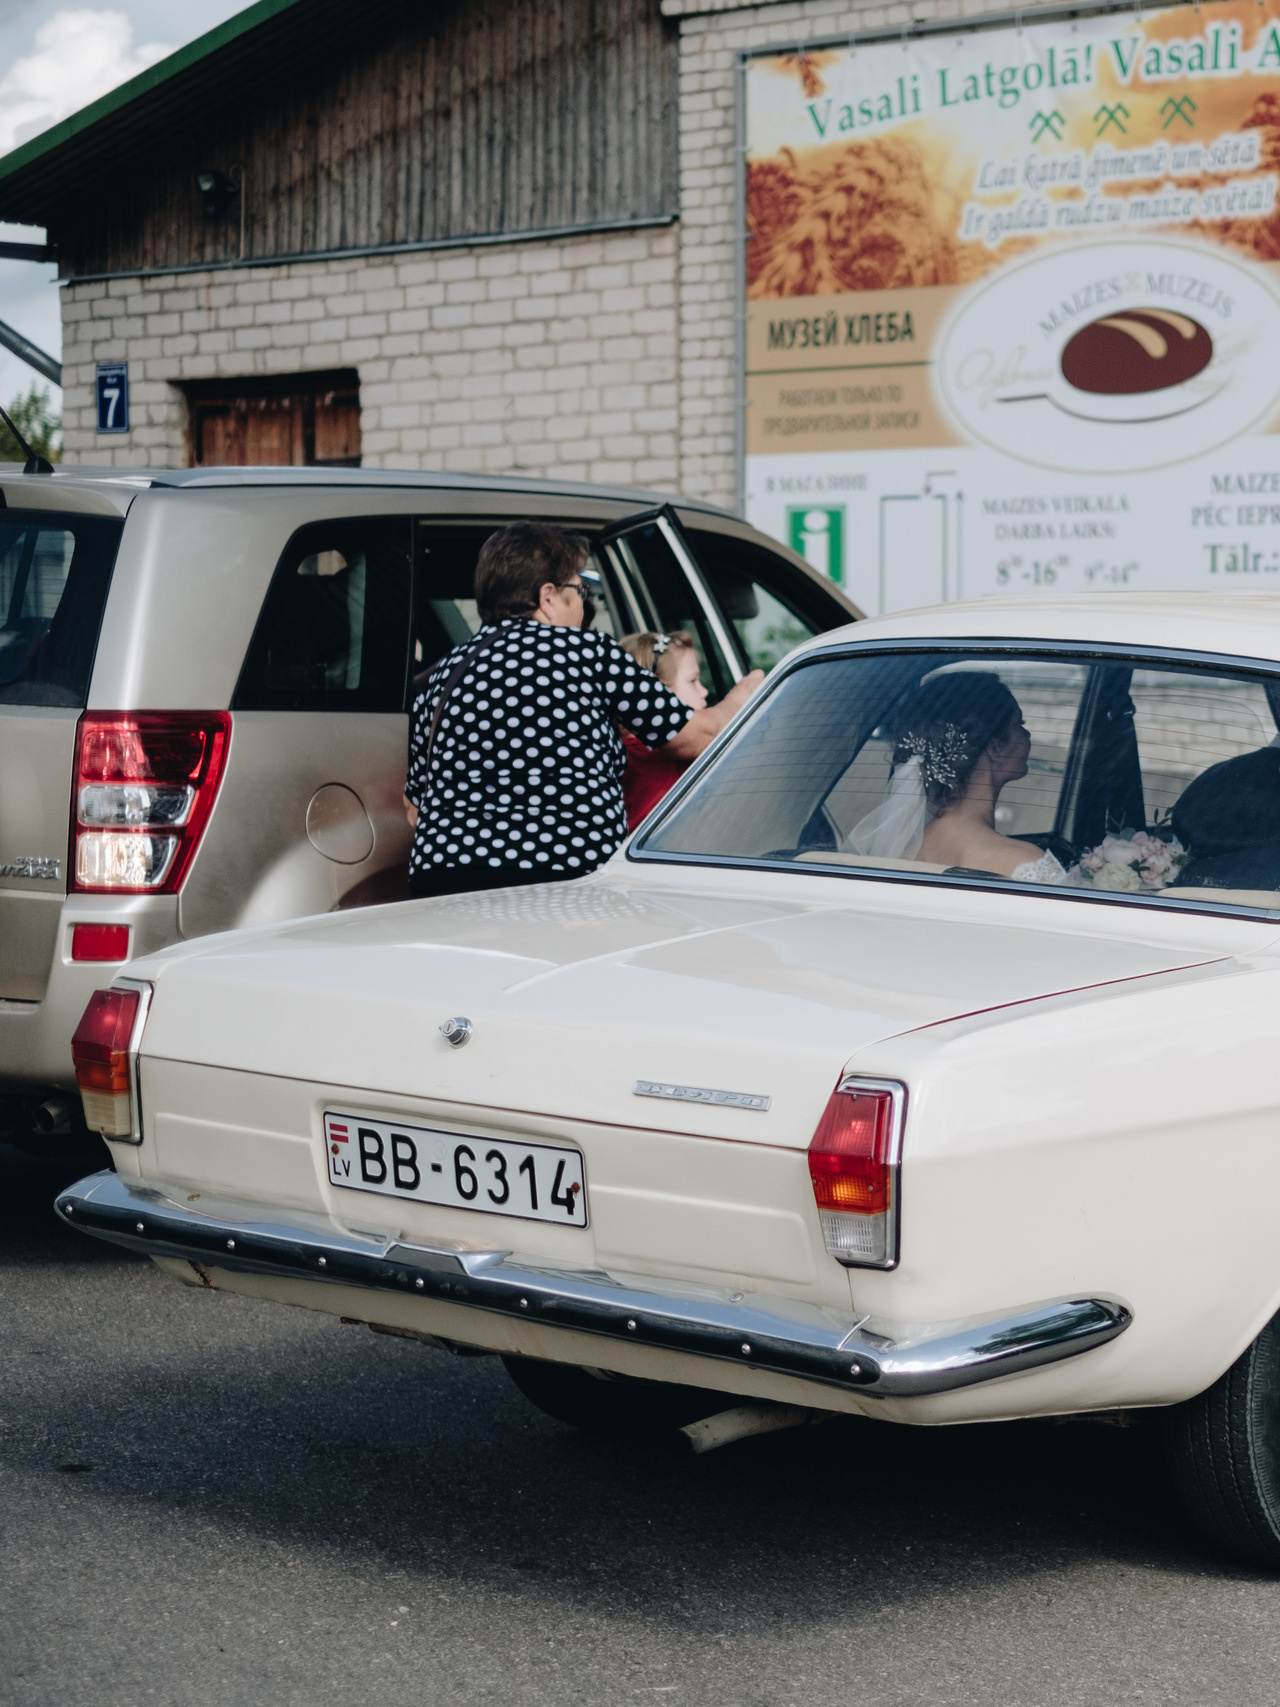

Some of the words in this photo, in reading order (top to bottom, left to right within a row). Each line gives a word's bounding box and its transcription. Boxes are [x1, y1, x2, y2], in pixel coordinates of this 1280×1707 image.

[806, 74, 921, 139] Vasali
[937, 43, 1094, 109] Latgolā!
[1110, 28, 1238, 78] Vasali
[1038, 277, 1124, 339] MAIZES
[1145, 272, 1236, 318] MUZEJS
[767, 310, 838, 350] МУЗЕЙ
[844, 311, 915, 345] ХЛЕБА
[103, 388, 120, 428] 7
[1191, 501, 1232, 527] PĒC
[332, 1157, 351, 1178] LV
[358, 1127, 576, 1216] BB-6314
